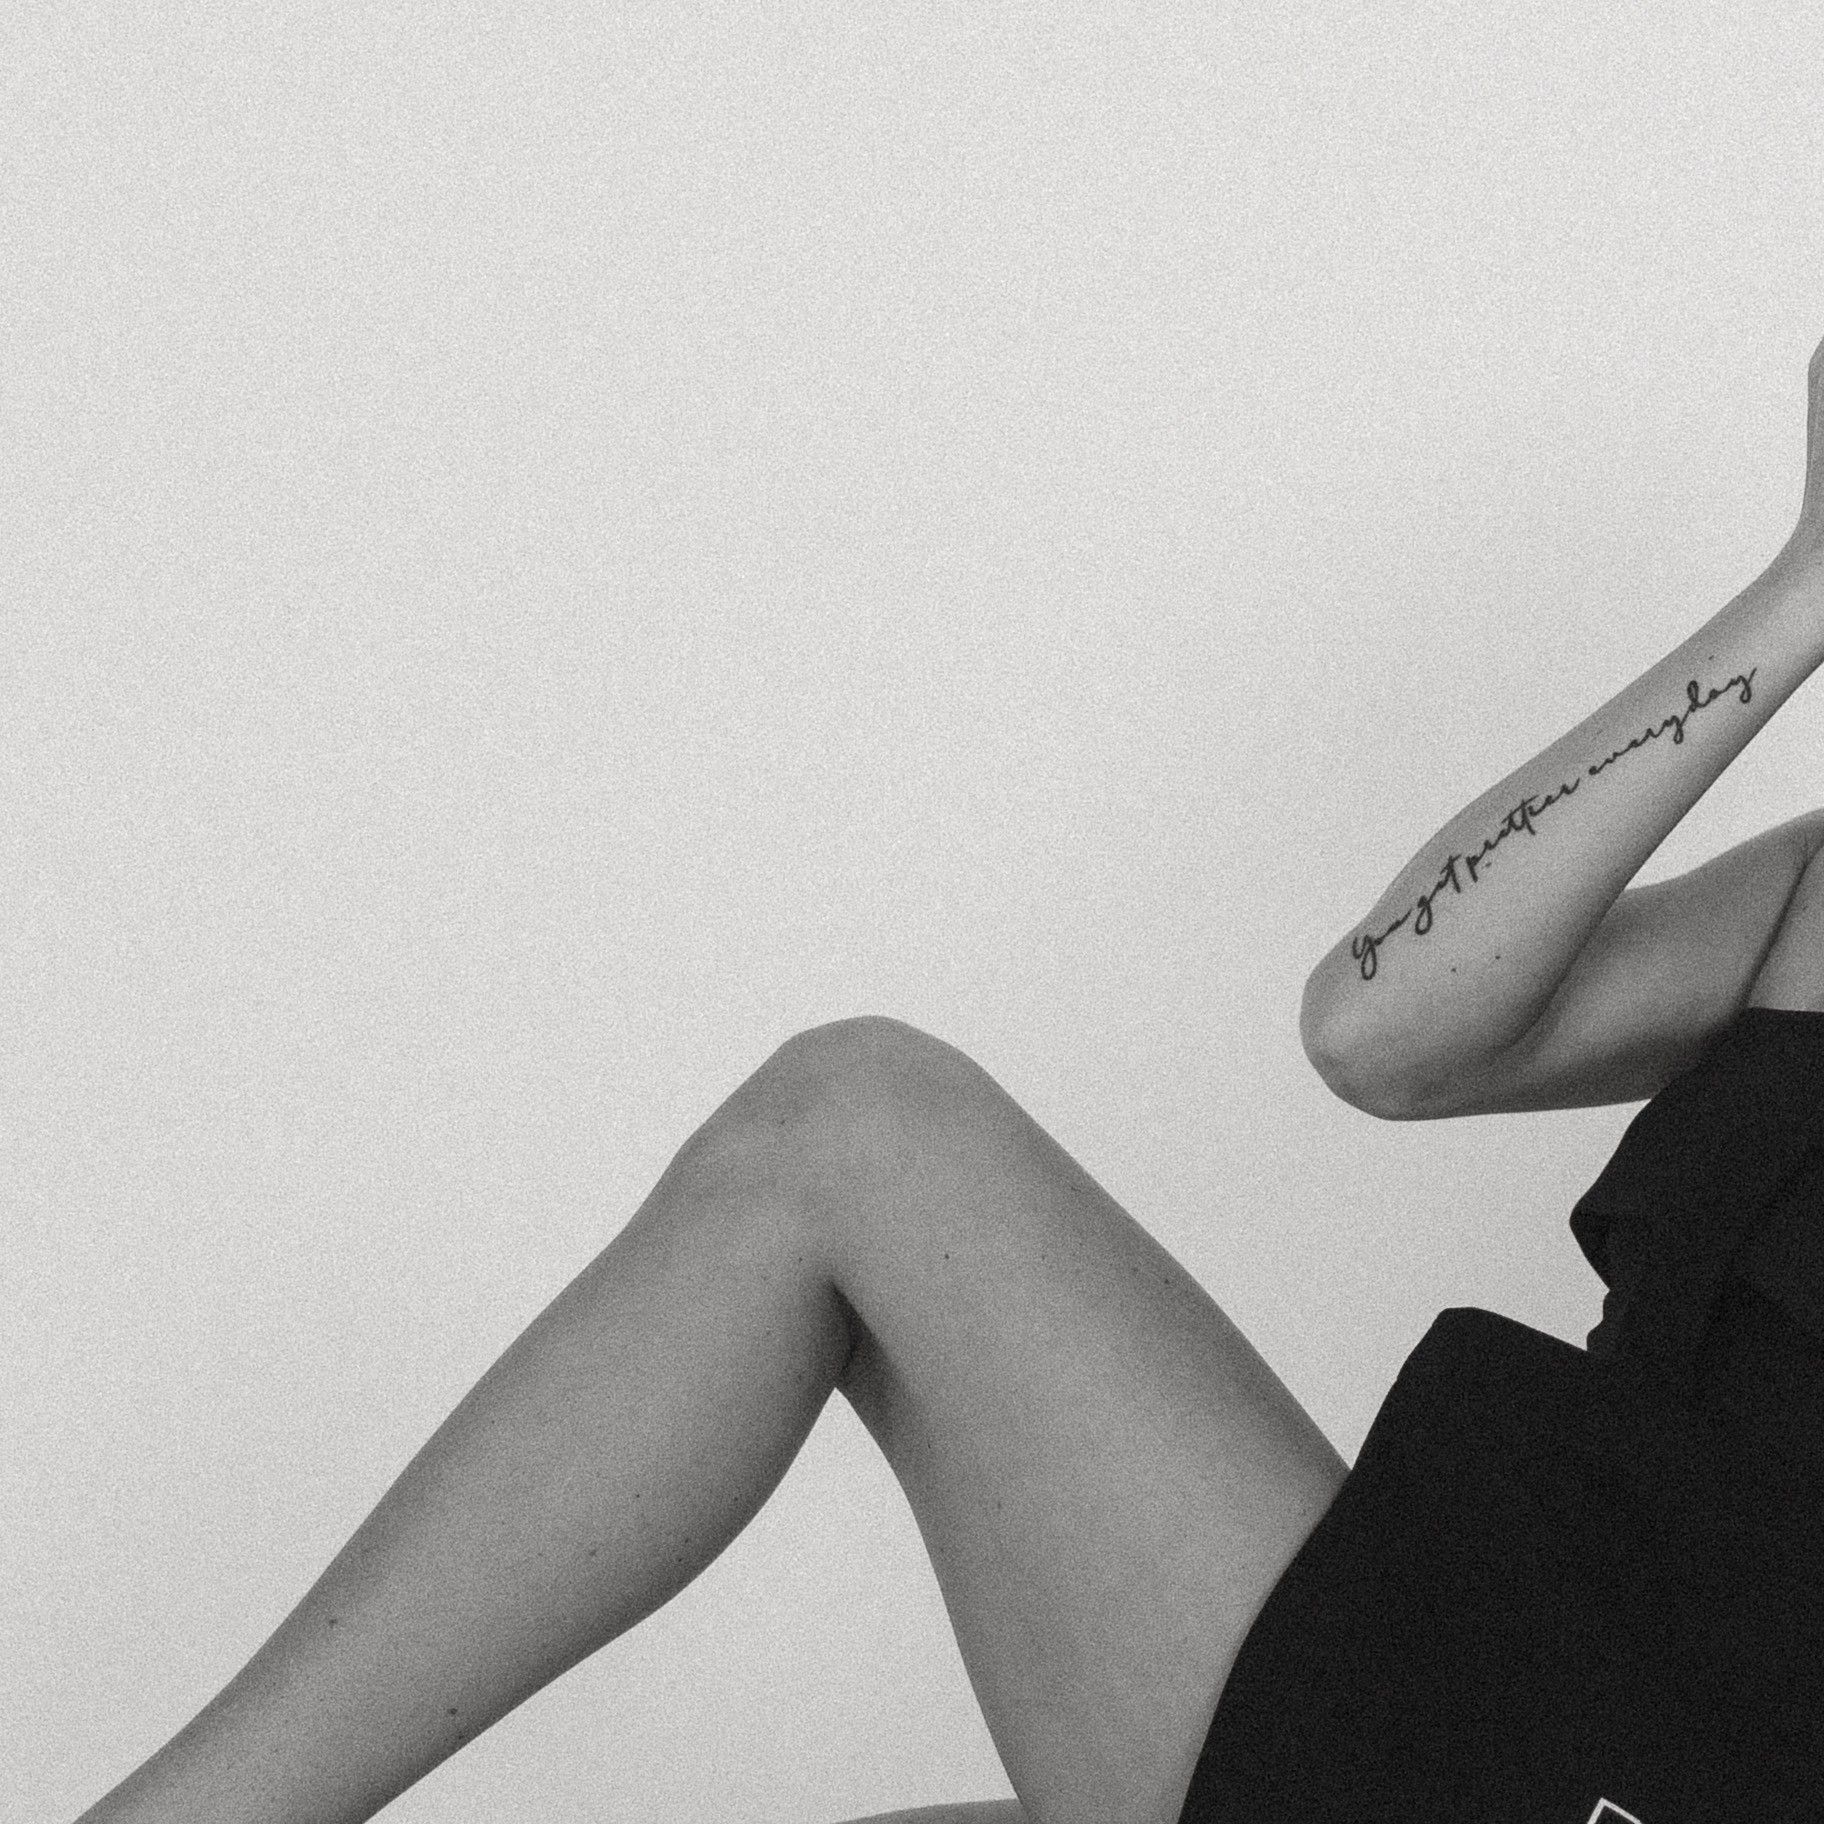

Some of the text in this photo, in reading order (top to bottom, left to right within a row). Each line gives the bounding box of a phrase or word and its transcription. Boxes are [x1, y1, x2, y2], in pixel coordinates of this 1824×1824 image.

[1413, 854, 1462, 937] get
[1465, 778, 1581, 883] prettier
[1587, 667, 1758, 777] everyday
